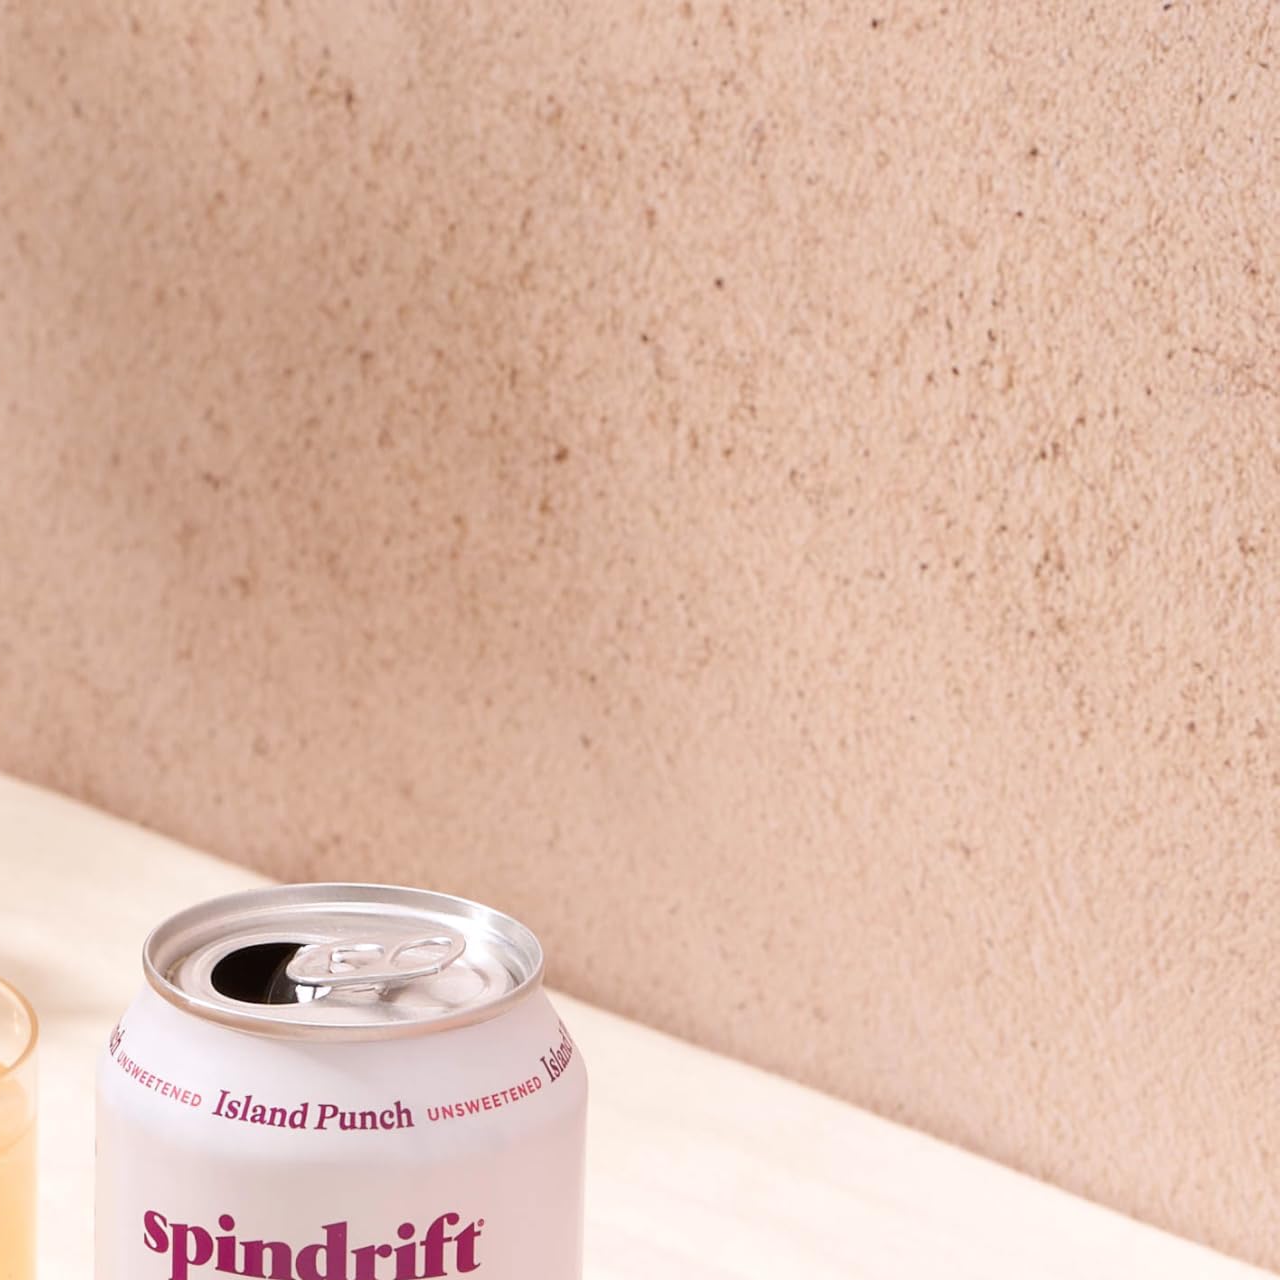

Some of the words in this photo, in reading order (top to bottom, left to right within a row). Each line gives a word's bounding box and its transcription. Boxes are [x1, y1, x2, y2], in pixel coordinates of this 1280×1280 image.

[117, 1051, 202, 1107] UNSWEETENED
[212, 1089, 308, 1130] Island
[314, 1101, 415, 1131] Punch
[427, 1076, 542, 1122] UNSWEETENED
